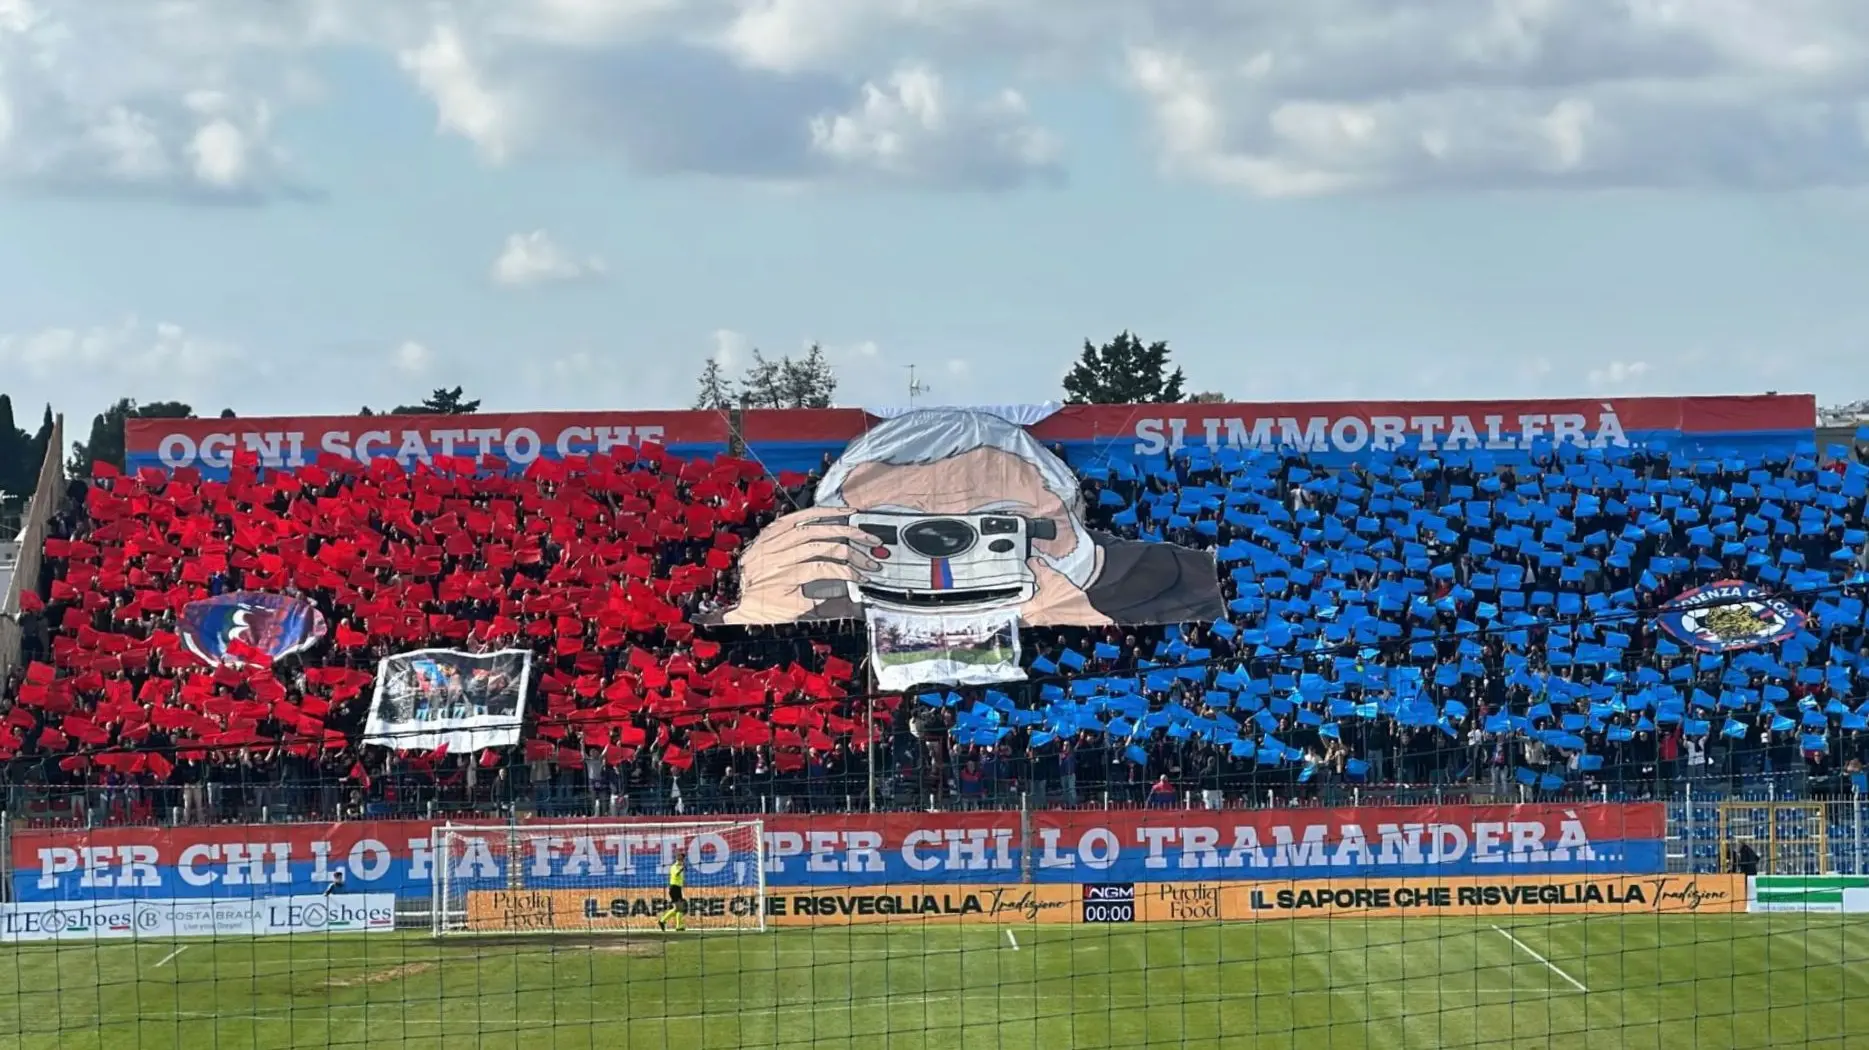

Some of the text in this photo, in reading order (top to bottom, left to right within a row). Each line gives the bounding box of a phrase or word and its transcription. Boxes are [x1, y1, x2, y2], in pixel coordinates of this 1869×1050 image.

[1135, 418, 1187, 455] SI
[158, 431, 305, 468] OGNI
[321, 427, 541, 466] SCATTO
[37, 845, 162, 889] PER
[178, 842, 292, 887] CHI
[310, 839, 391, 883] LO
[408, 836, 500, 880] HA
[531, 833, 747, 885] FATTO,
[763, 831, 886, 872] PER
[902, 829, 1013, 871] CHI
[1040, 827, 1120, 869] LO
[1089, 886, 1133, 898] NGM
[1251, 889, 1274, 909] IL
[1276, 887, 1391, 909] SAPORE
[1394, 886, 1453, 907] CHE
[1458, 884, 1604, 906] RISVEGLIA
[1608, 883, 1646, 904] LA
[165, 911, 210, 921] COSTA
[584, 897, 607, 918] IL
[610, 896, 725, 917] SAPORE
[730, 896, 787, 916] CHE
[793, 894, 938, 916] RISVEGLIA
[943, 894, 984, 914] LA
[1086, 905, 1131, 921] 00:00
[1170, 901, 1218, 918] Food
[504, 909, 553, 927] Food
